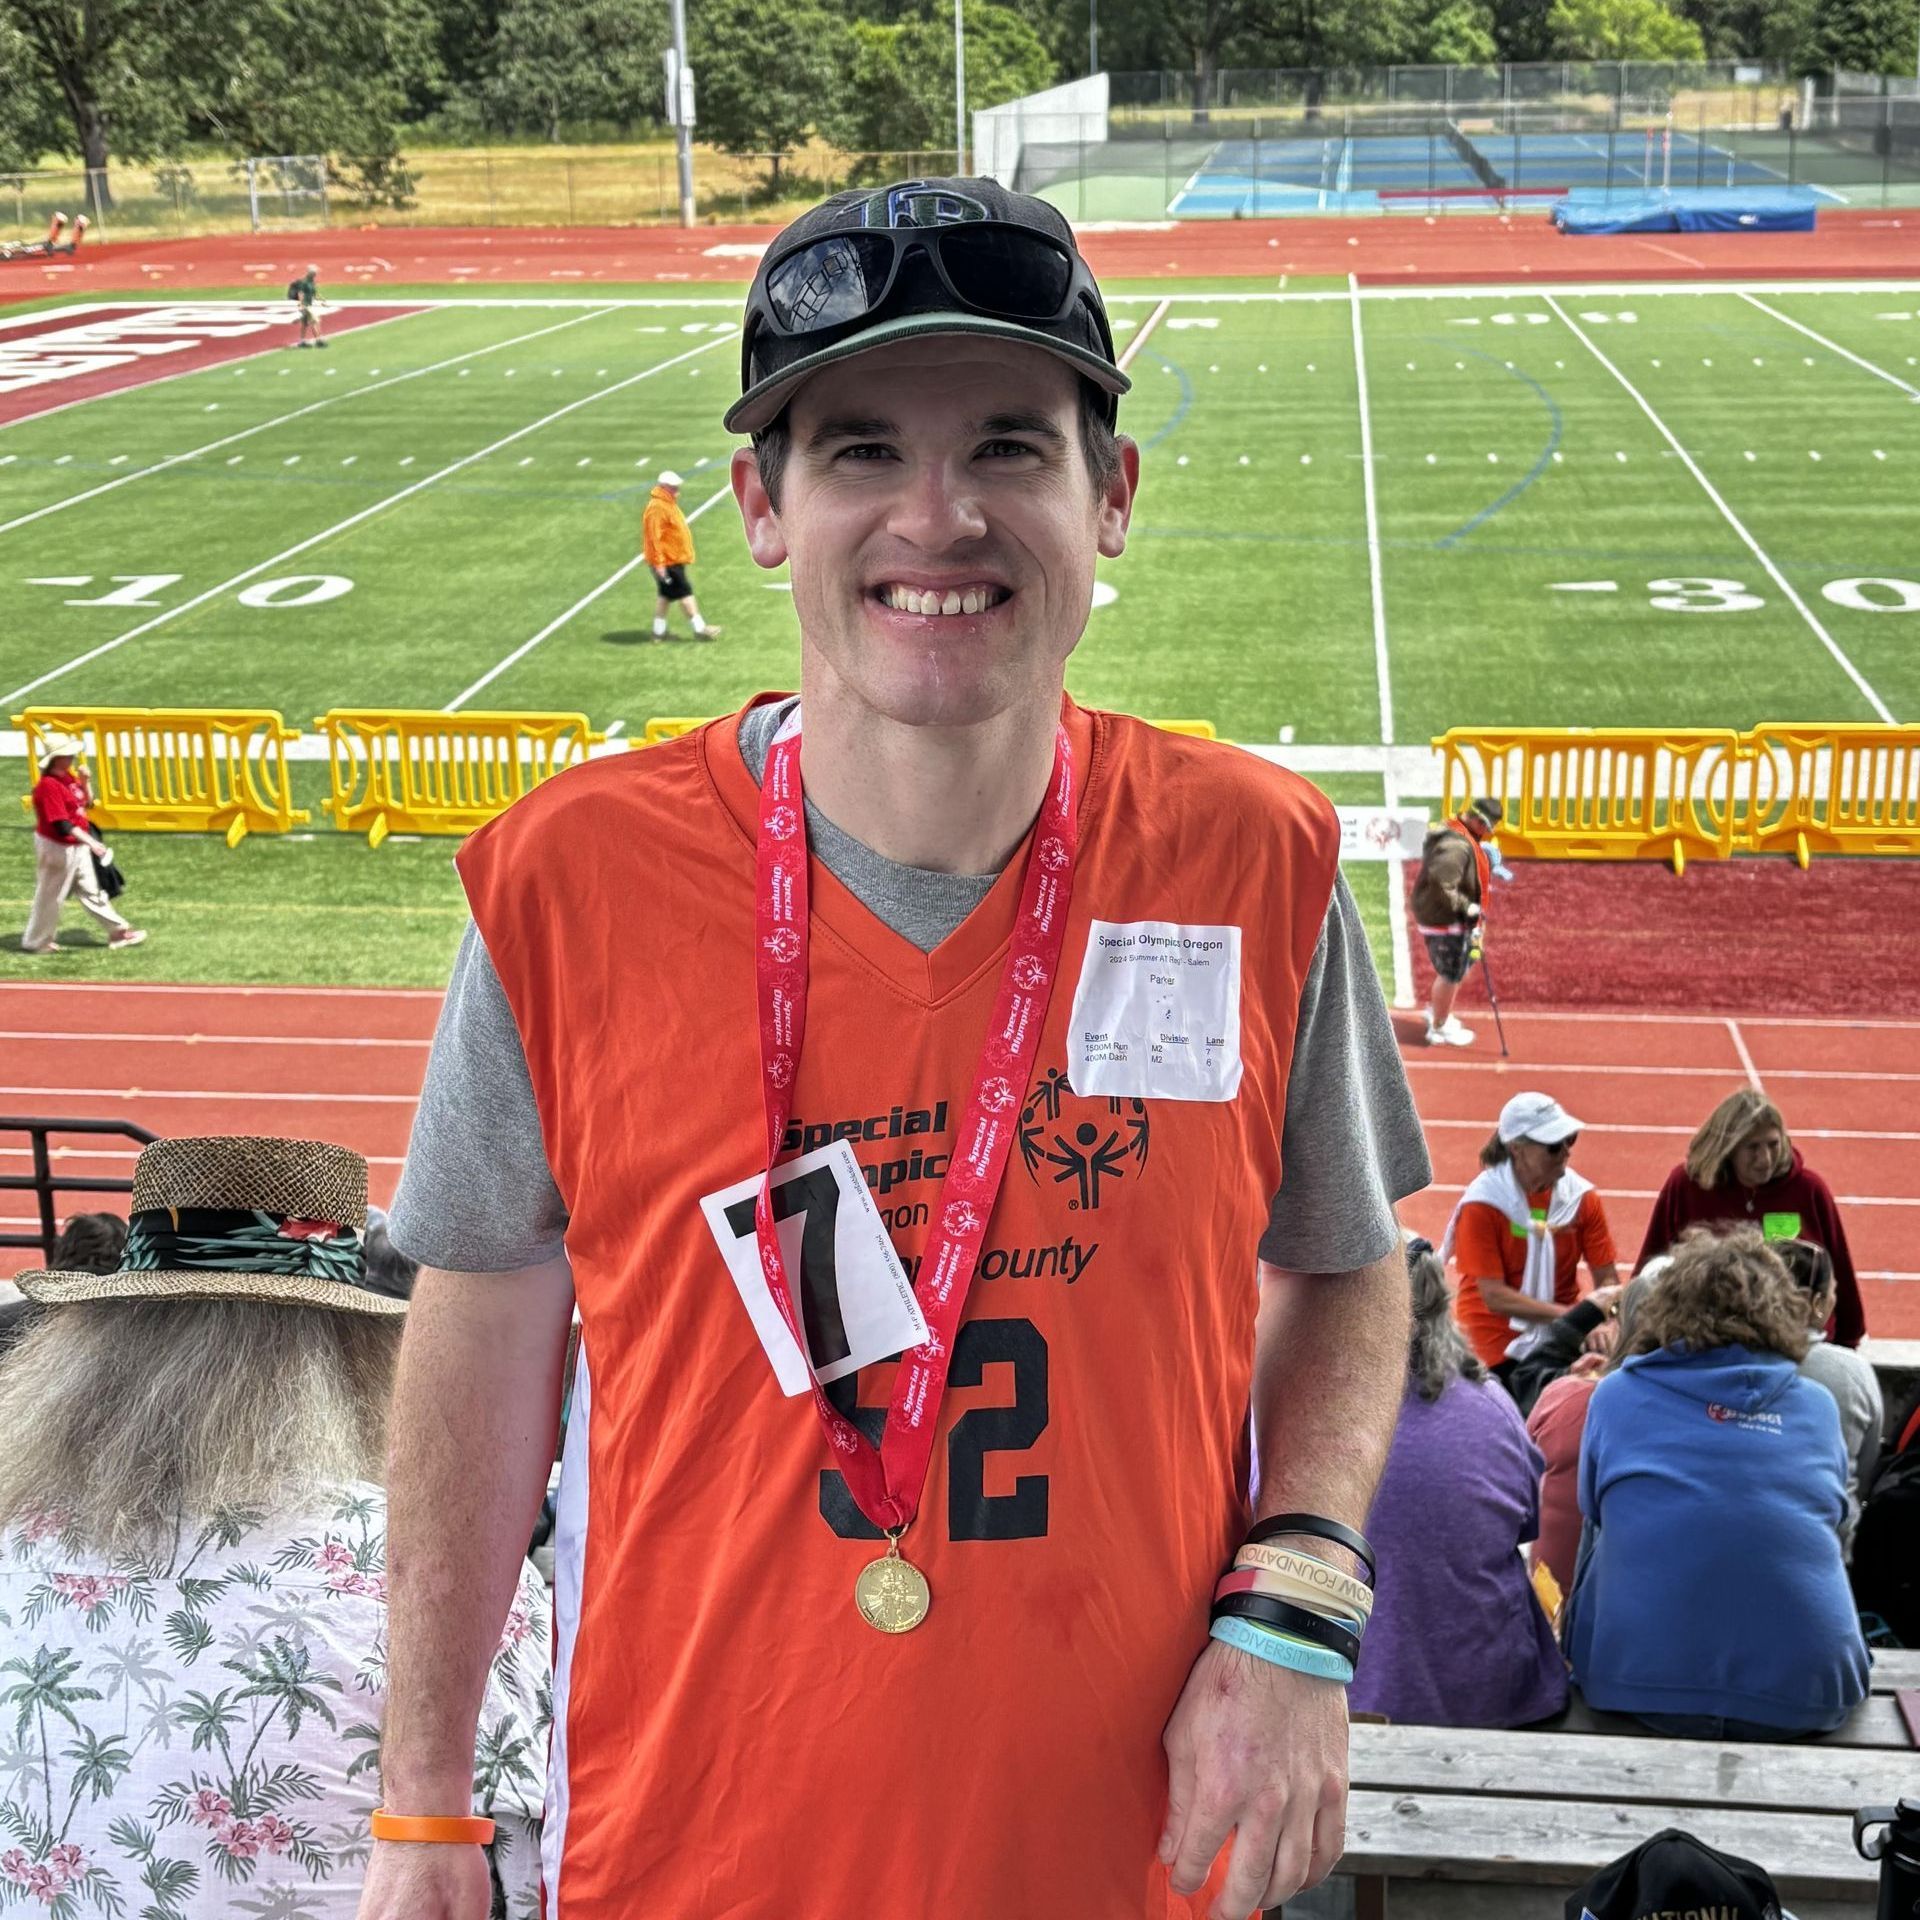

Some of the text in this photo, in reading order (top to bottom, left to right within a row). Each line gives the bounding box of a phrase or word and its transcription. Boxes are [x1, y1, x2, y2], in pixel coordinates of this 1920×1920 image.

[772, 865, 782, 922] Olympics
[784, 876, 793, 921] Special
[1032, 874, 1048, 919] Special
[1040, 877, 1058, 933] Olympics
[1099, 935, 1223, 951] Special Olympics Oregon
[1109, 955, 1127, 964] 2024
[1129, 954, 1159, 962] Summer
[1187, 958, 1210, 967] Salem
[772, 989, 782, 1045] Olympics
[783, 999, 793, 1047] Special
[1003, 994, 1022, 1040] Special
[1011, 997, 1032, 1054] Olympics
[1084, 1033, 1225, 1045] Event Division Lane
[1109, 1053, 1128, 1061] Dash
[1151, 1055, 1163, 1064] M2
[1113, 1042, 1128, 1050] Run
[1151, 1044, 1163, 1053] M2
[968, 1117, 987, 1163] Special
[976, 1119, 999, 1178] Olympics
[724, 1165, 852, 1370] 7
[931, 1240, 951, 1288] Special
[939, 1244, 962, 1302] Olympics
[975, 1236, 1099, 1284] ounty
[903, 1365, 919, 1413] Special
[911, 1367, 930, 1428] Olympics
[1238, 1630, 1313, 1667] DIVERSITY
